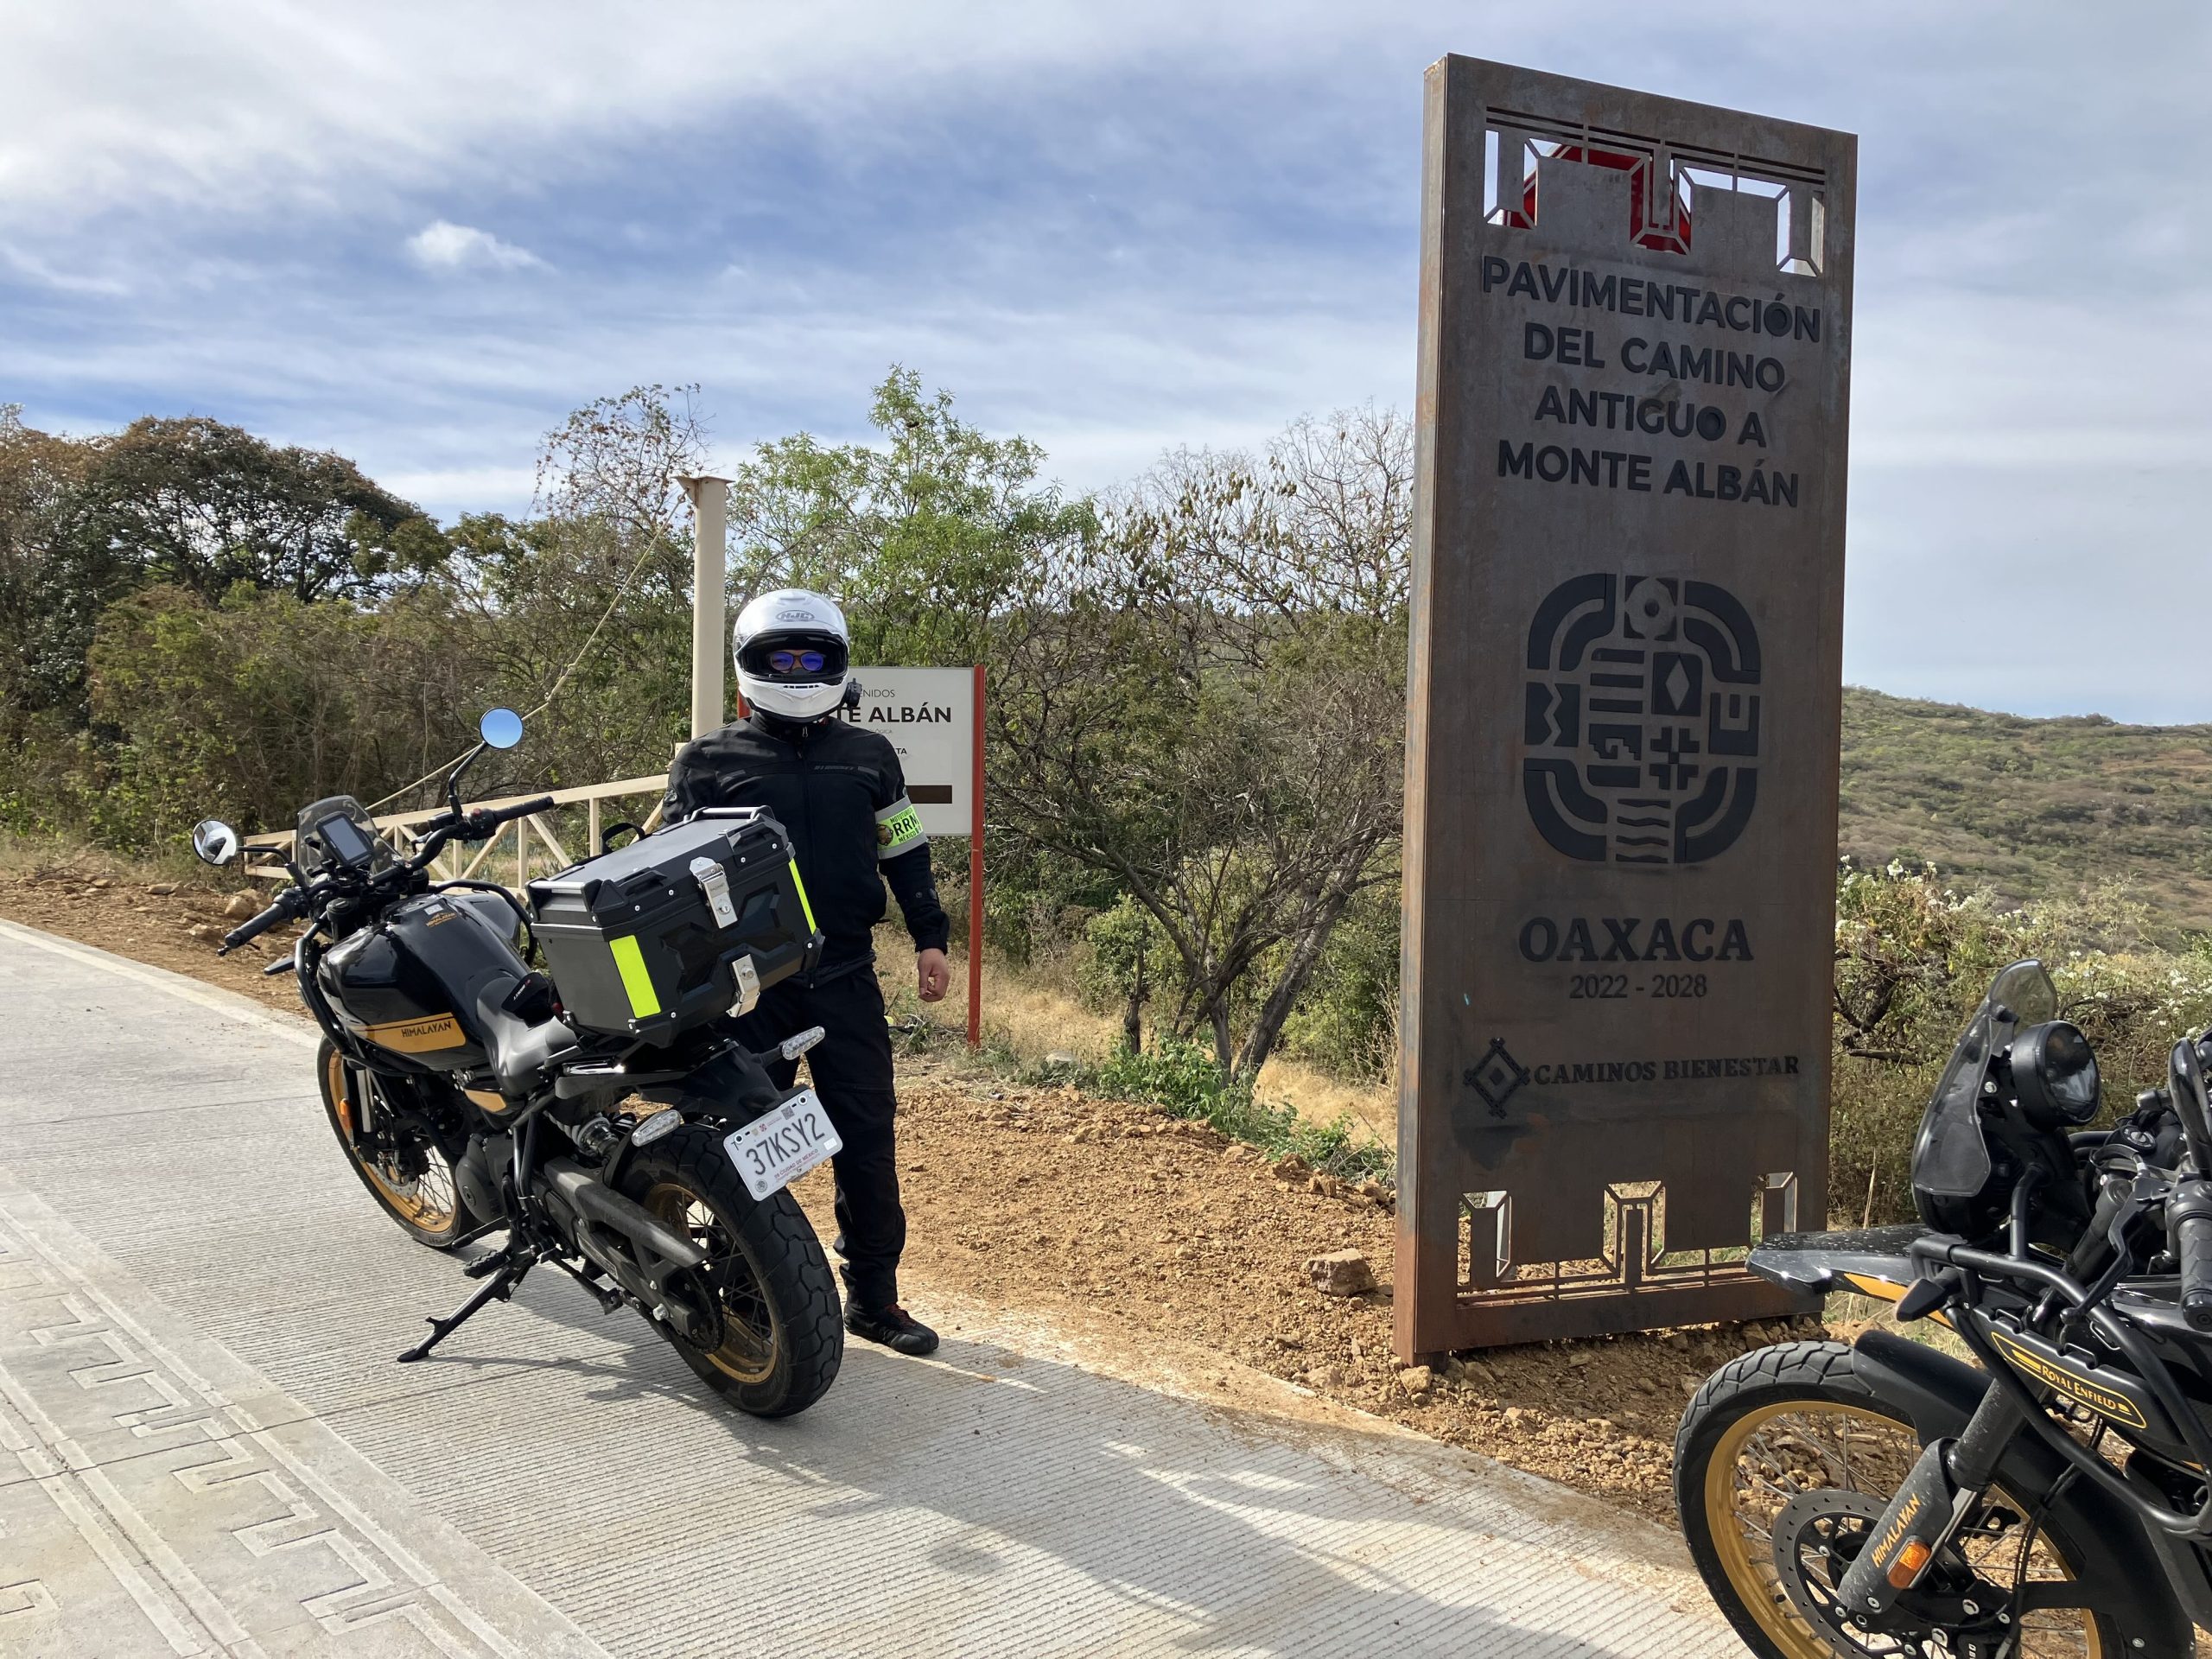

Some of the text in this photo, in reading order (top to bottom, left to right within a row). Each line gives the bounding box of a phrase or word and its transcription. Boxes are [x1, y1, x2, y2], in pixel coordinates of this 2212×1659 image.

[1483, 256, 1821, 343] PAVIMENTACIÓN
[1524, 322, 1785, 392] DEL CAMINO
[1535, 385, 1766, 448] ANTIGUO A
[1498, 440, 1798, 507] MONTE ALBÁN
[868, 702, 951, 723] ALBÁN
[1518, 917, 1754, 963] OAXACA
[1569, 974, 1628, 999] 2022
[1651, 973, 1707, 998] 2028
[401, 1021, 451, 1038] HIMALAYAN
[1534, 1055, 1799, 1085] CAMINOS BIENESTAR
[747, 1113, 825, 1175] 37KSY2
[2042, 1366, 2116, 1409] ROYAL ENFIELD
[1872, 1493, 1920, 1567] HIMALAYAN
